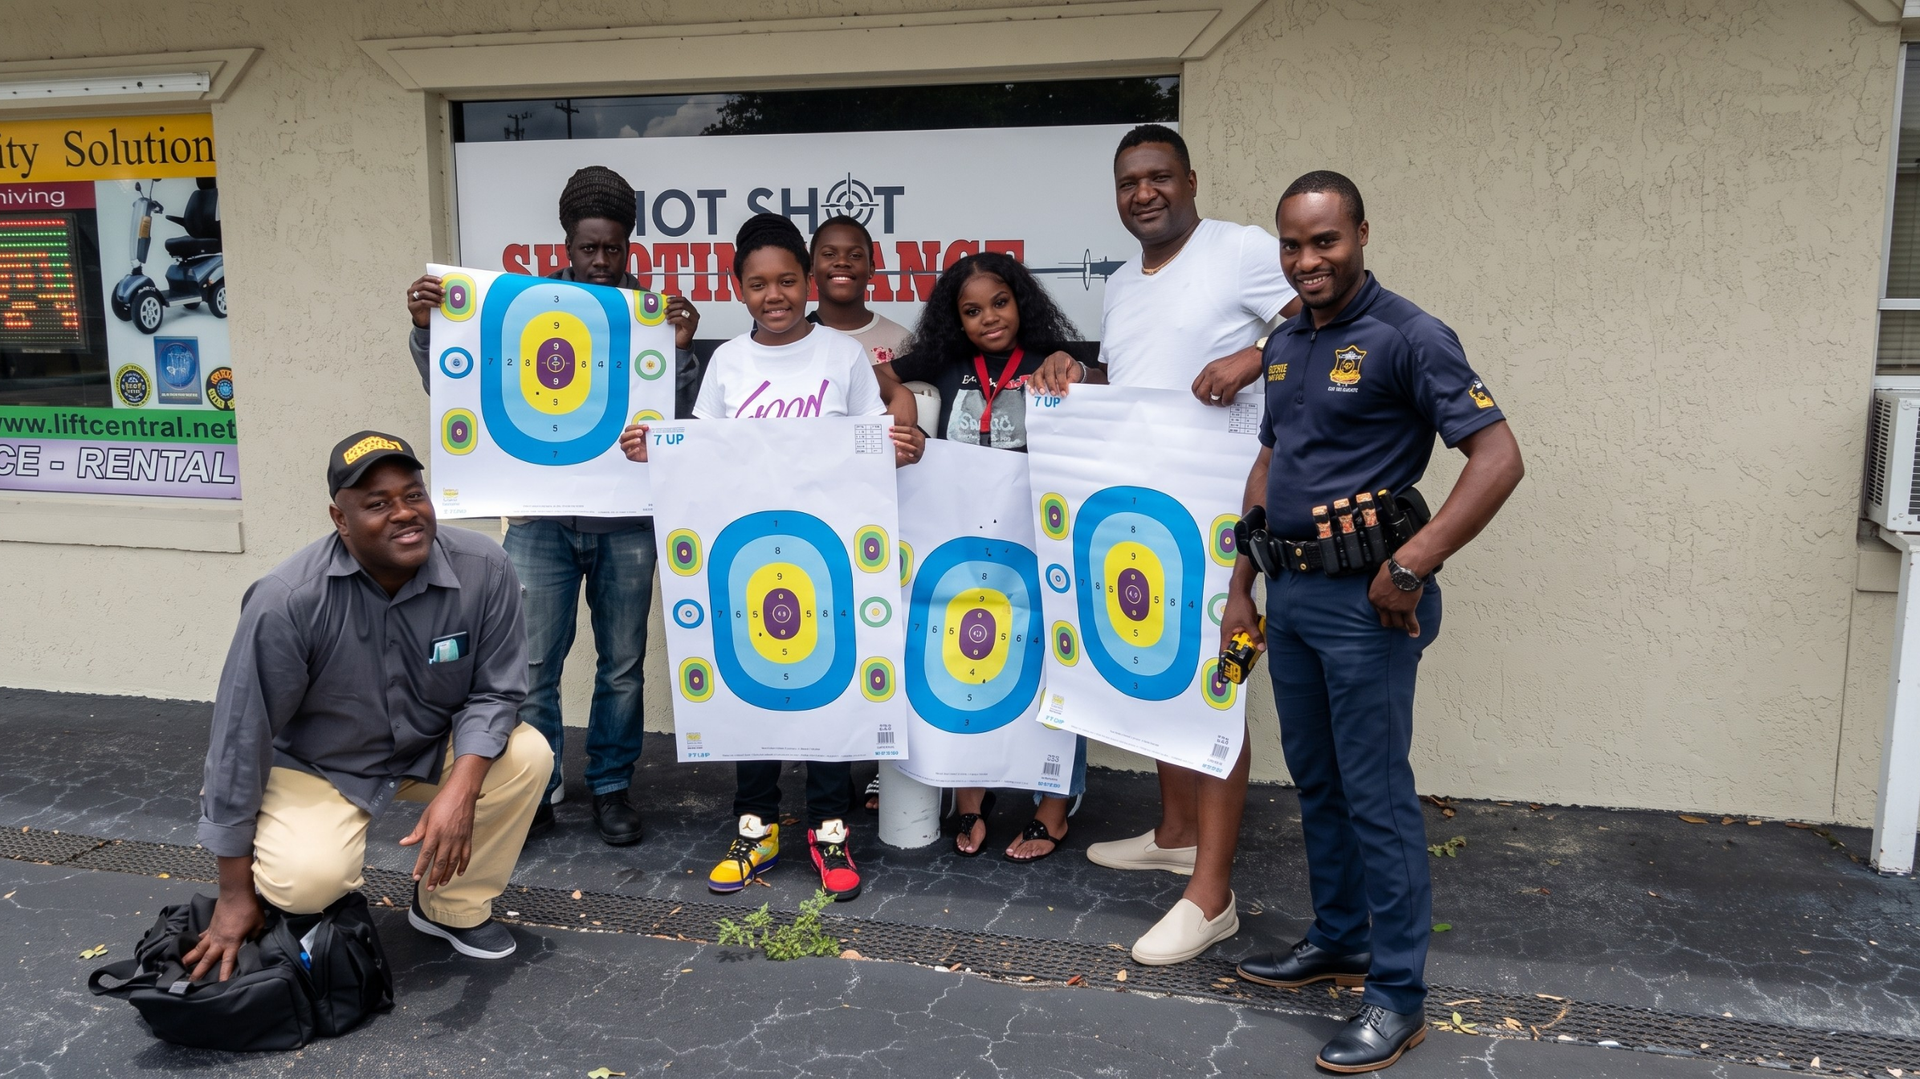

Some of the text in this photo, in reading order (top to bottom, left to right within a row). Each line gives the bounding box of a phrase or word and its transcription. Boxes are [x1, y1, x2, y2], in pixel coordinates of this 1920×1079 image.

[63, 125, 216, 168] Solution
[635, 187, 727, 238] OT
[553, 321, 560, 330] 9
[1034, 396, 1061, 408] 7 UP
[0, 413, 237, 440] ww.liftcentral.net
[653, 433, 684, 446] 7 UP
[77, 446, 236, 484] RENTAL
